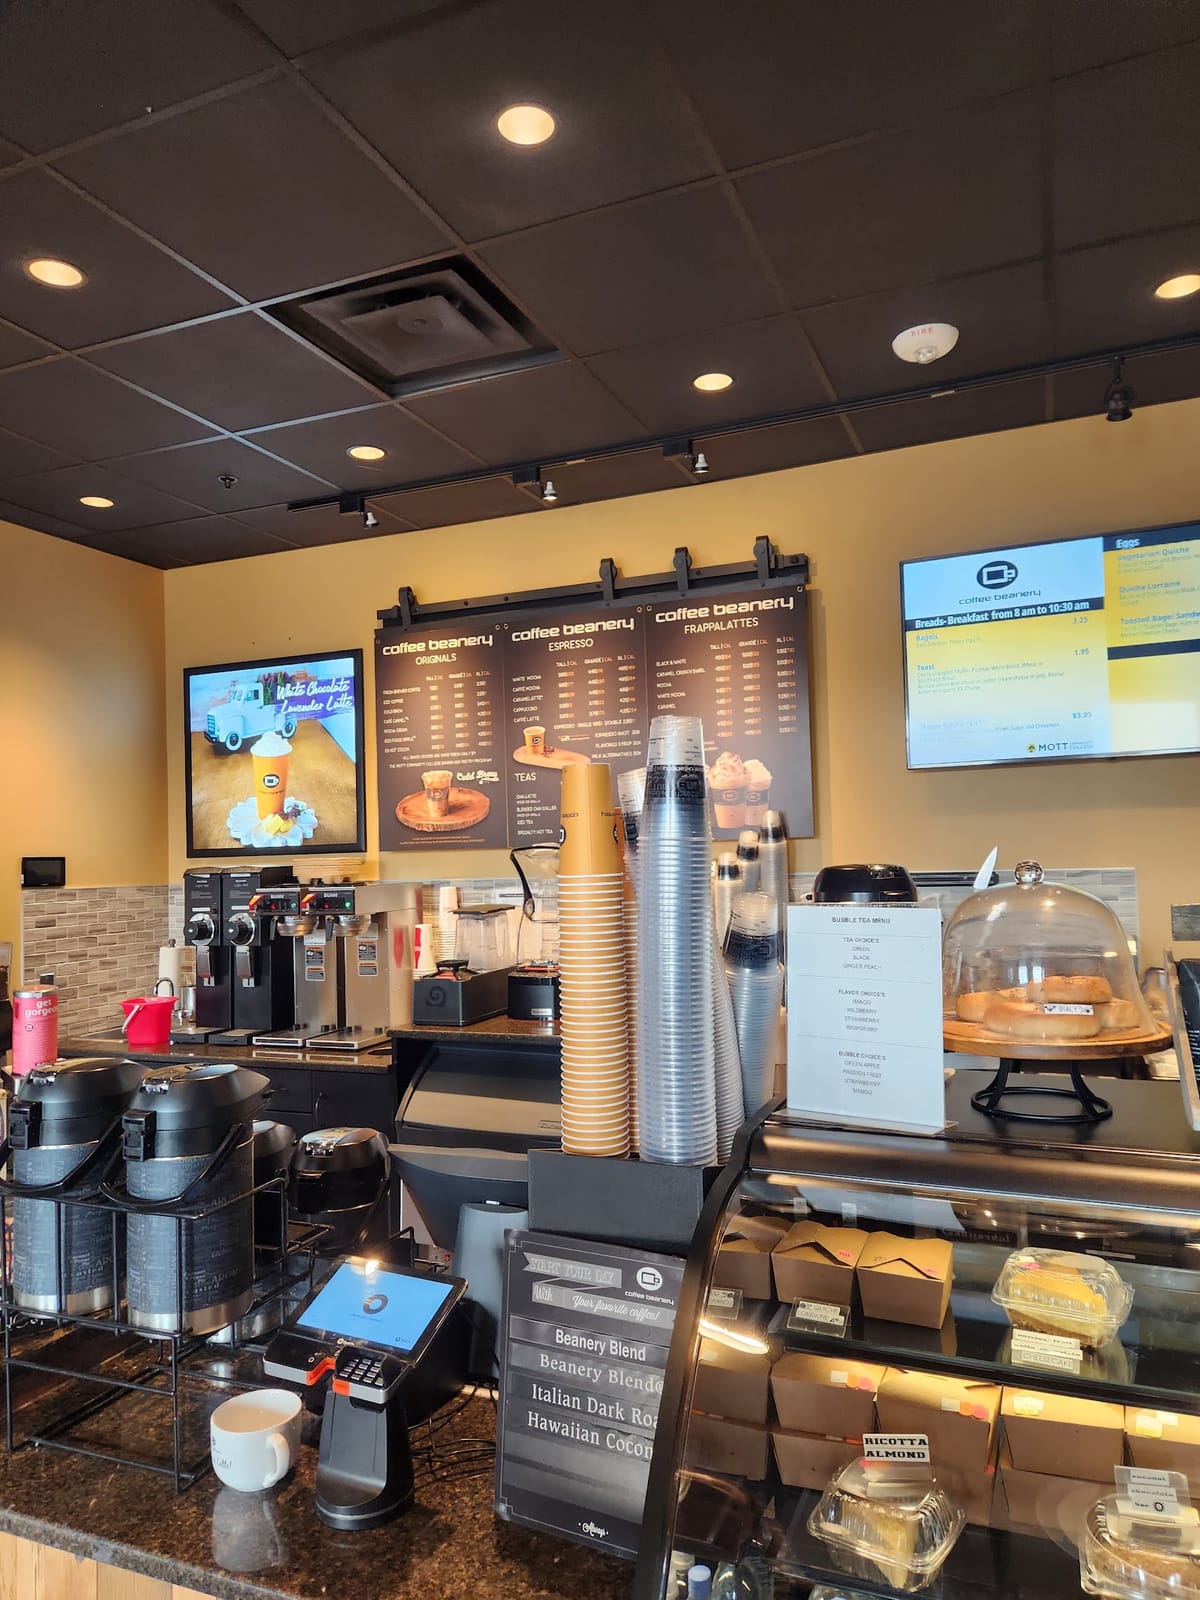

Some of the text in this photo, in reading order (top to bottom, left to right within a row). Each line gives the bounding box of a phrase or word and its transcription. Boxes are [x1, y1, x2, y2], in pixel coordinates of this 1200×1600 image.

[911, 326, 934, 336] FIRE
[1116, 537, 1140, 551] Eggs
[958, 589, 1042, 605] coffee beanery
[655, 596, 794, 623] coffee beanery
[948, 612, 989, 626] Breakfast
[991, 610, 1015, 621] from
[1014, 609, 1021, 618] 8
[1022, 609, 1036, 617] am
[1037, 606, 1048, 615] to
[1049, 602, 1073, 614] 10:30
[1074, 602, 1090, 610] am
[511, 618, 635, 642] coffee beanery
[684, 617, 759, 635] FRAPPALATTES
[382, 634, 493, 656] coffee beanery
[548, 638, 594, 652] ESPRESSO
[916, 632, 938, 642] Bagels
[415, 652, 457, 666] ORIGINALS
[277, 677, 350, 700] White Chocolate
[281, 692, 353, 714] Lavender Latte
[1038, 742, 1068, 752] MOTT
[514, 772, 537, 782] TEAS
[831, 917, 858, 925] BUBBLE
[529, 1256, 561, 1278] START
[564, 1263, 593, 1282] YOUR
[534, 1285, 661, 1322] With Your favorite coffee!
[624, 1290, 674, 1306] coffee beanery
[555, 1328, 646, 1362] Beanery Blend
[539, 1353, 602, 1383] Beanery
[1023, 1352, 1073, 1368] CHEESECAKE
[531, 1383, 581, 1411] Italian
[586, 1396, 625, 1421] Dark
[527, 1410, 653, 1460] Hawaiian Cocon
[864, 1437, 928, 1446] RICOTTA
[866, 1450, 926, 1459] ALMOND
